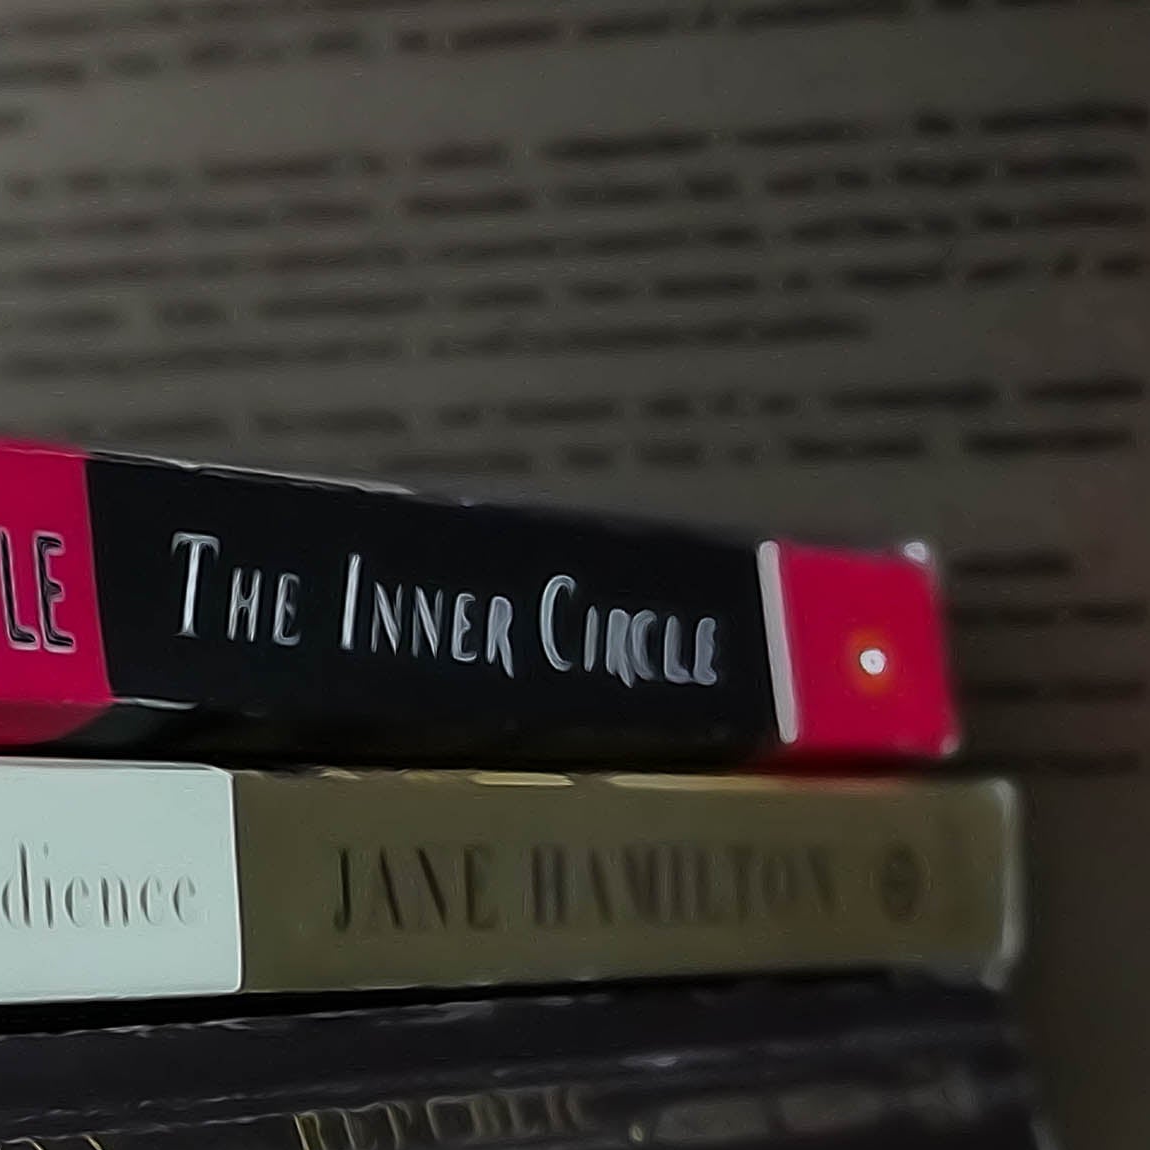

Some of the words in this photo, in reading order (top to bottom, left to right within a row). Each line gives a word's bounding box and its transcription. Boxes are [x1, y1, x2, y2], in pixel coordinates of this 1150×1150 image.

[171, 529, 302, 647] THE
[340, 552, 514, 679] INNER
[333, 845, 496, 931] JANE
